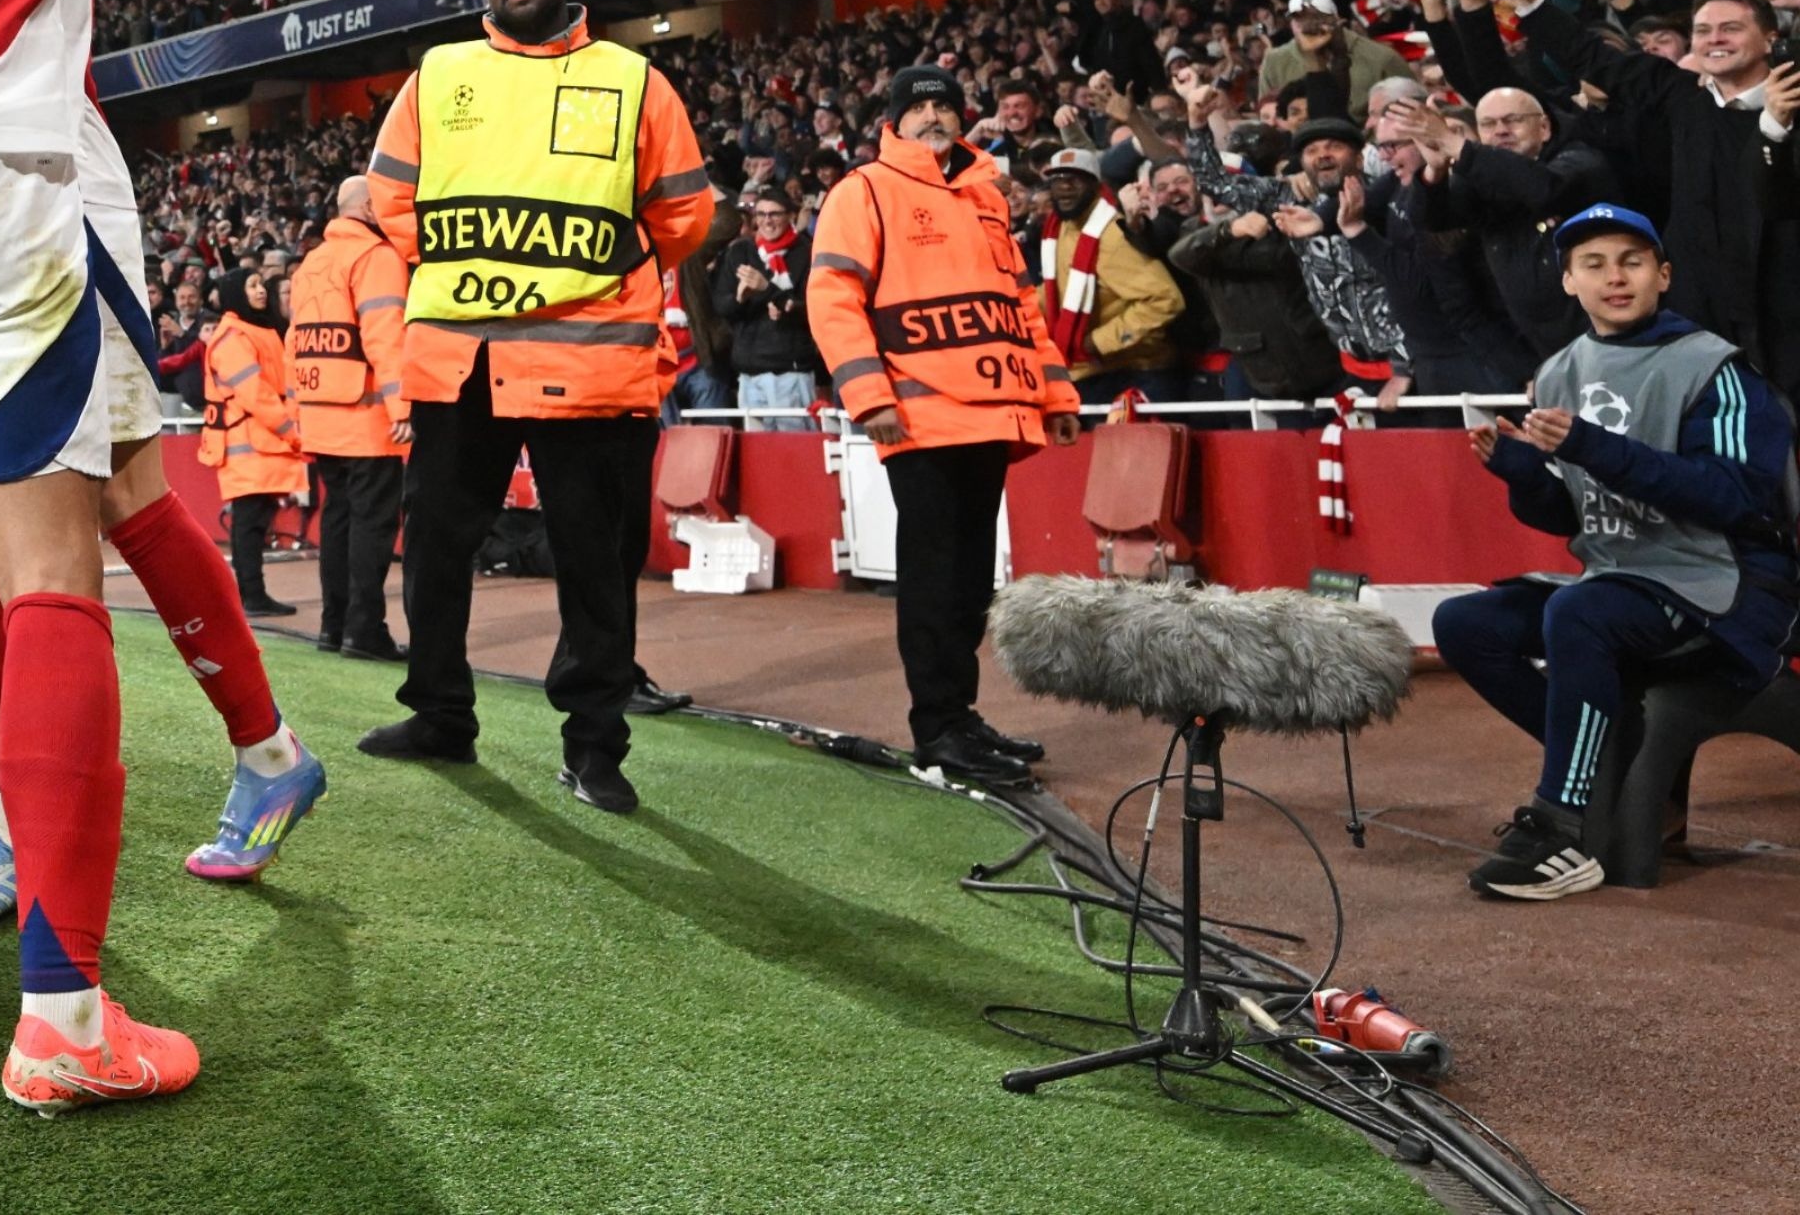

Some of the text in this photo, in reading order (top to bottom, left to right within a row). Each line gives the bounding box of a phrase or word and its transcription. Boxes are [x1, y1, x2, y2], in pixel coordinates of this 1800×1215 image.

[306, 4, 374, 45] JUST EAT
[423, 207, 616, 264] STEWARD
[452, 271, 547, 314] 096
[296, 328, 352, 354] WARD
[297, 366, 321, 392] 48
[976, 352, 1038, 391] 996
[1583, 514, 1637, 540] GUE
[170, 616, 205, 640] FC
